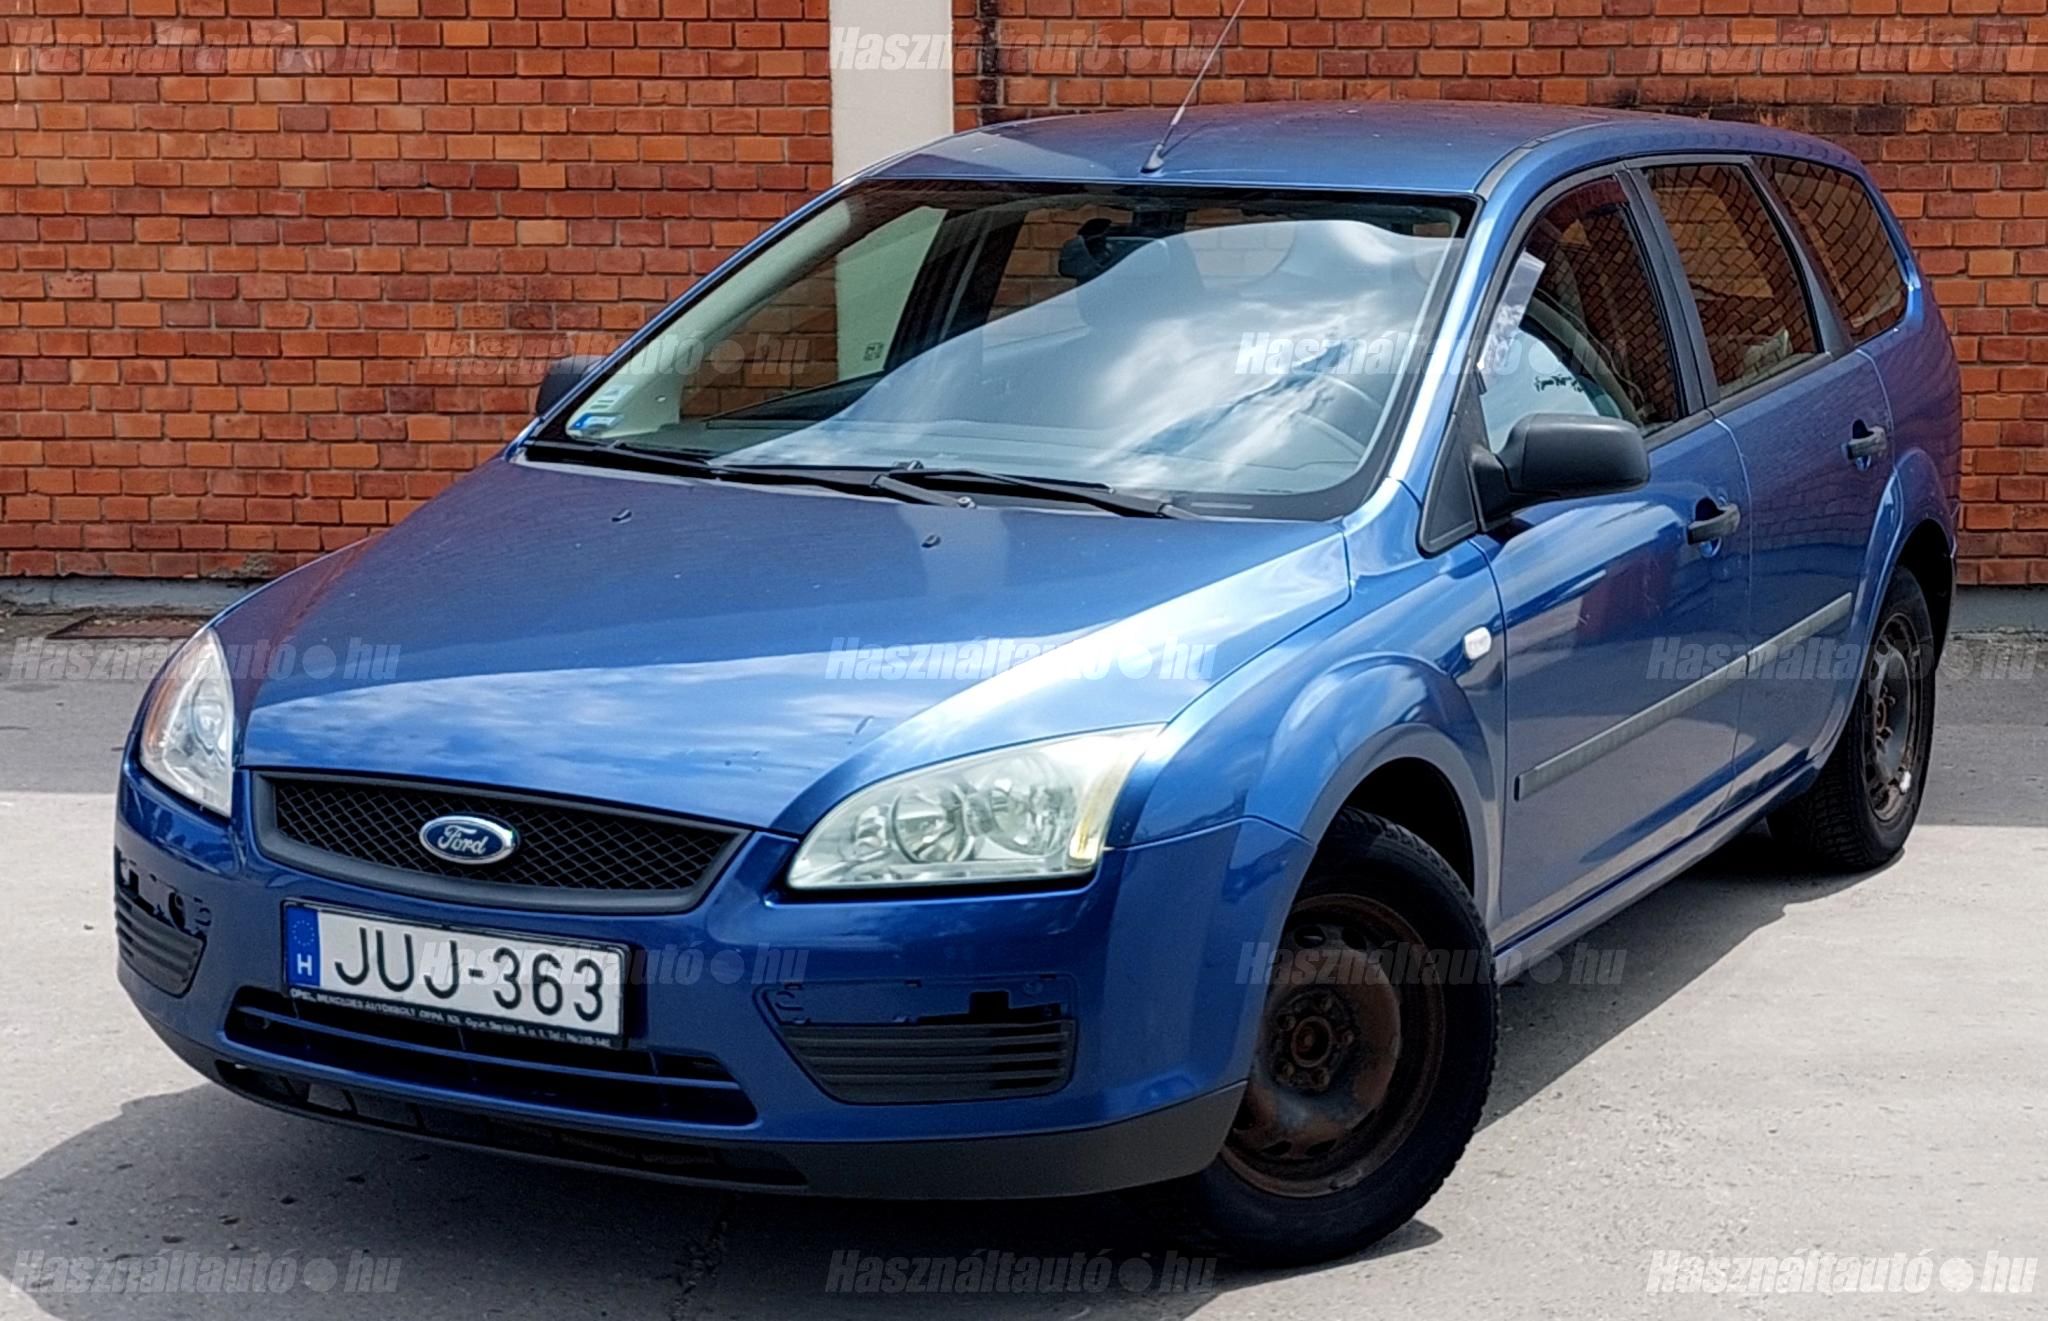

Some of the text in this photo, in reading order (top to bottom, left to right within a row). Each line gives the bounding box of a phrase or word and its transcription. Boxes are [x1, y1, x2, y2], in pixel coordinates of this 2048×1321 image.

[437, 825, 489, 855] Ford
[296, 926, 603, 1023] H JUJ-363
